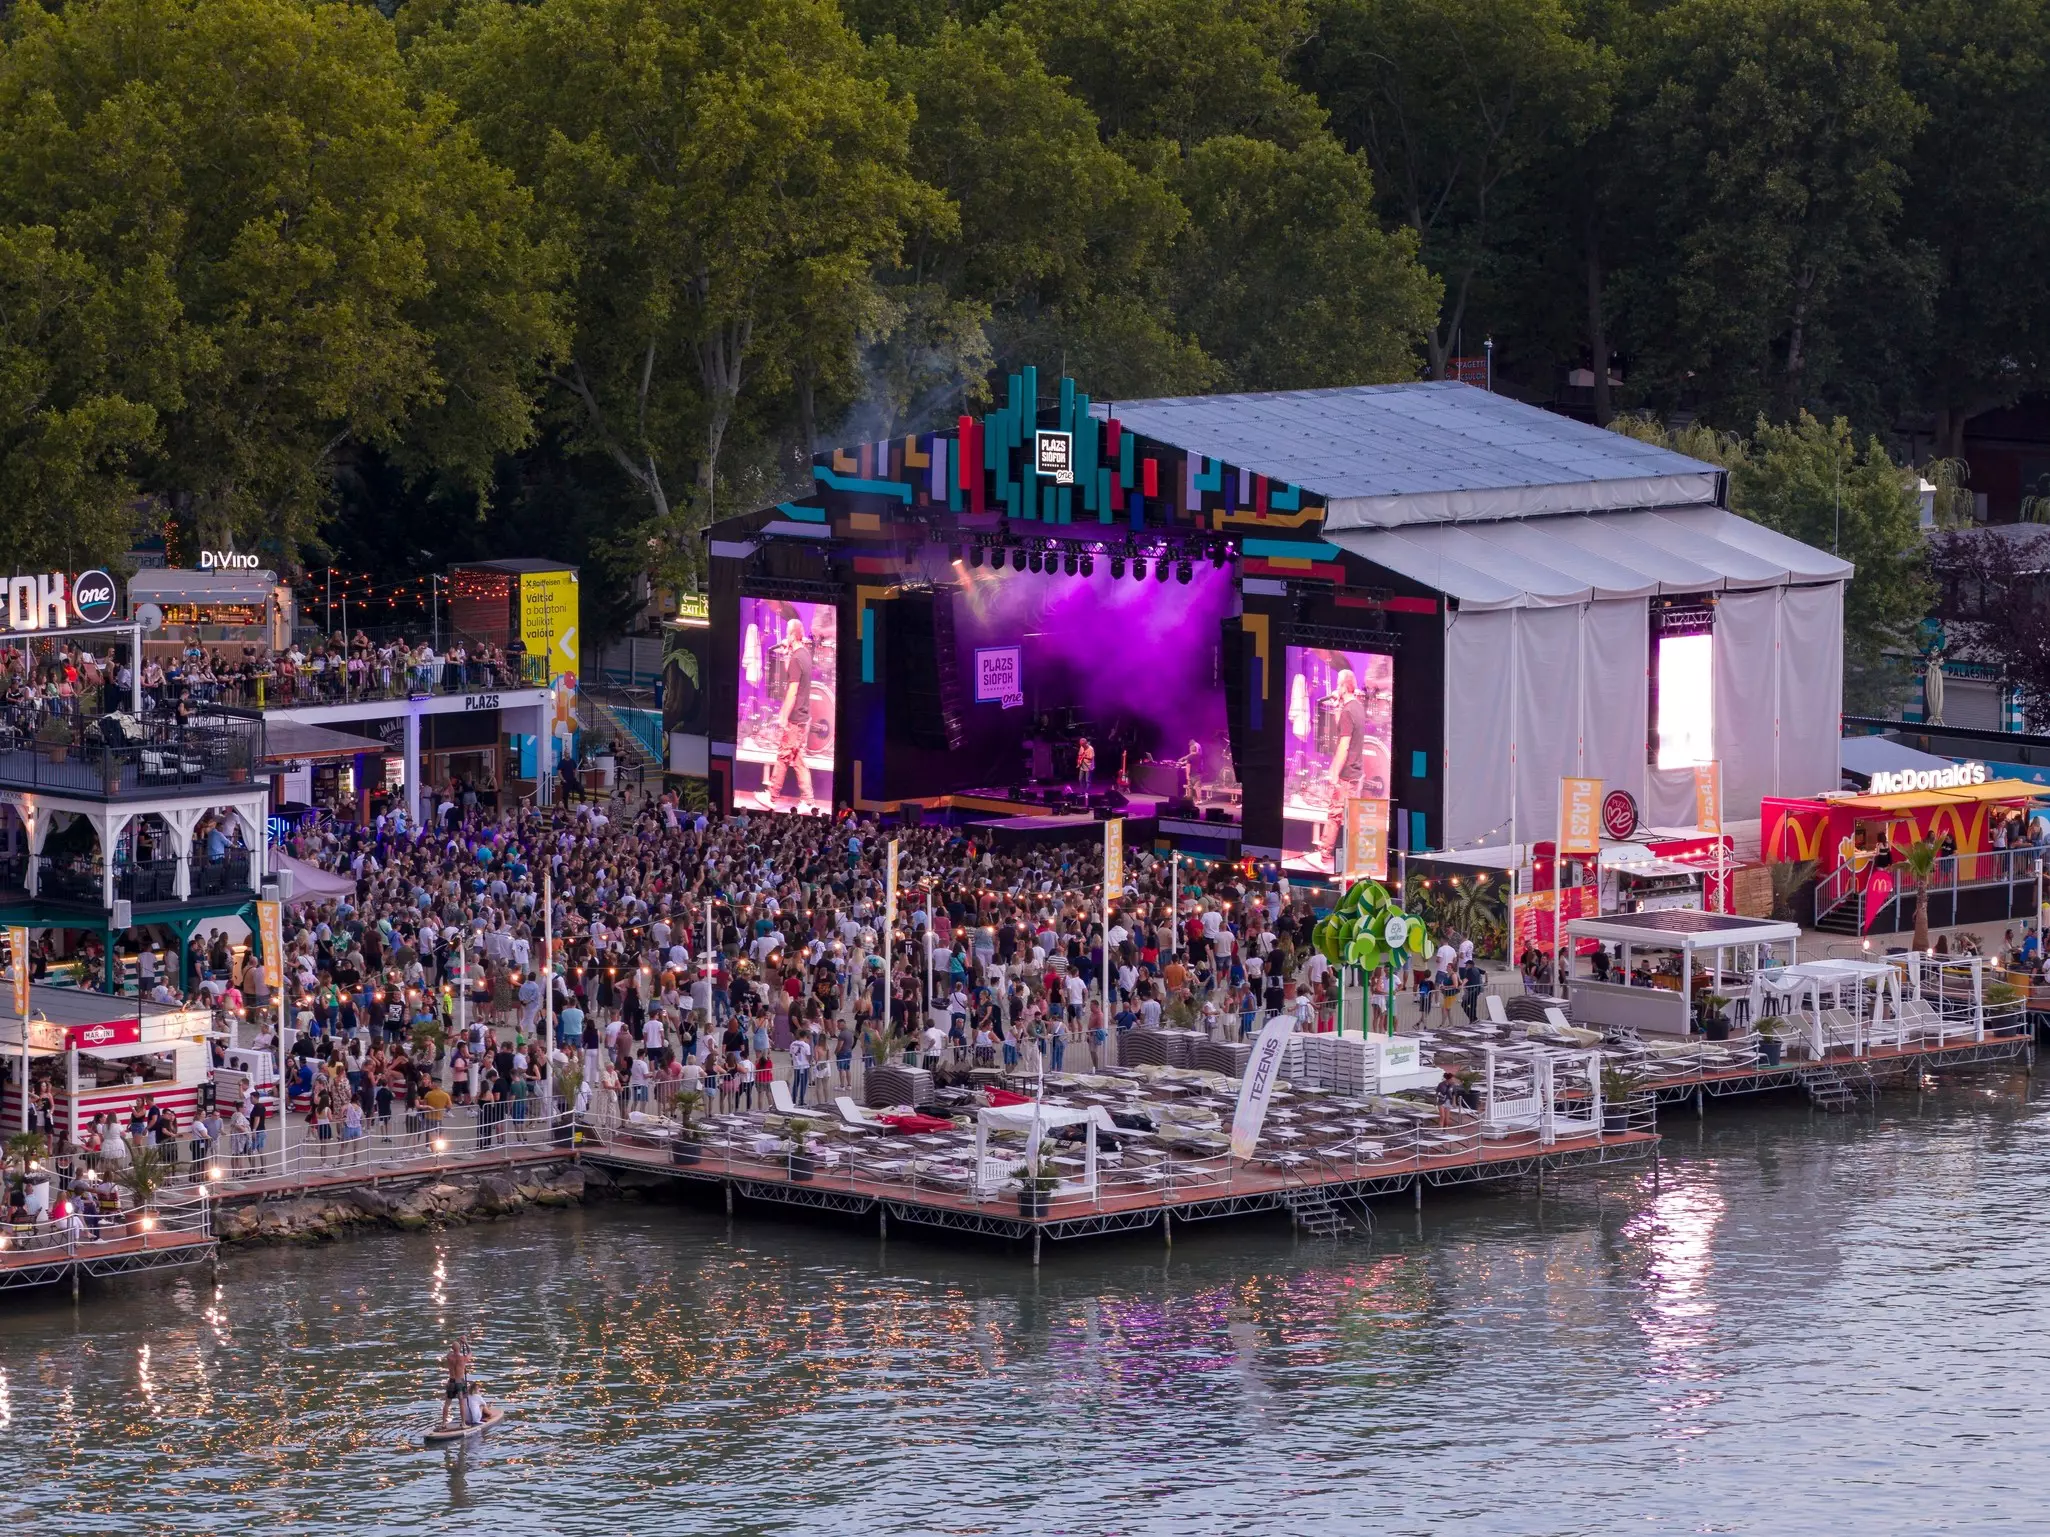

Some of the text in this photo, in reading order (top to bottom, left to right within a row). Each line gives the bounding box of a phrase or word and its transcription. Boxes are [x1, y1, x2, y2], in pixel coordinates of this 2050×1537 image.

[79, 587, 110, 603] one
[533, 602, 567, 615] baatoni
[681, 604, 699, 615] EXIT
[1870, 762, 1986, 794] McDonald's
[905, 944, 913, 956] 14
